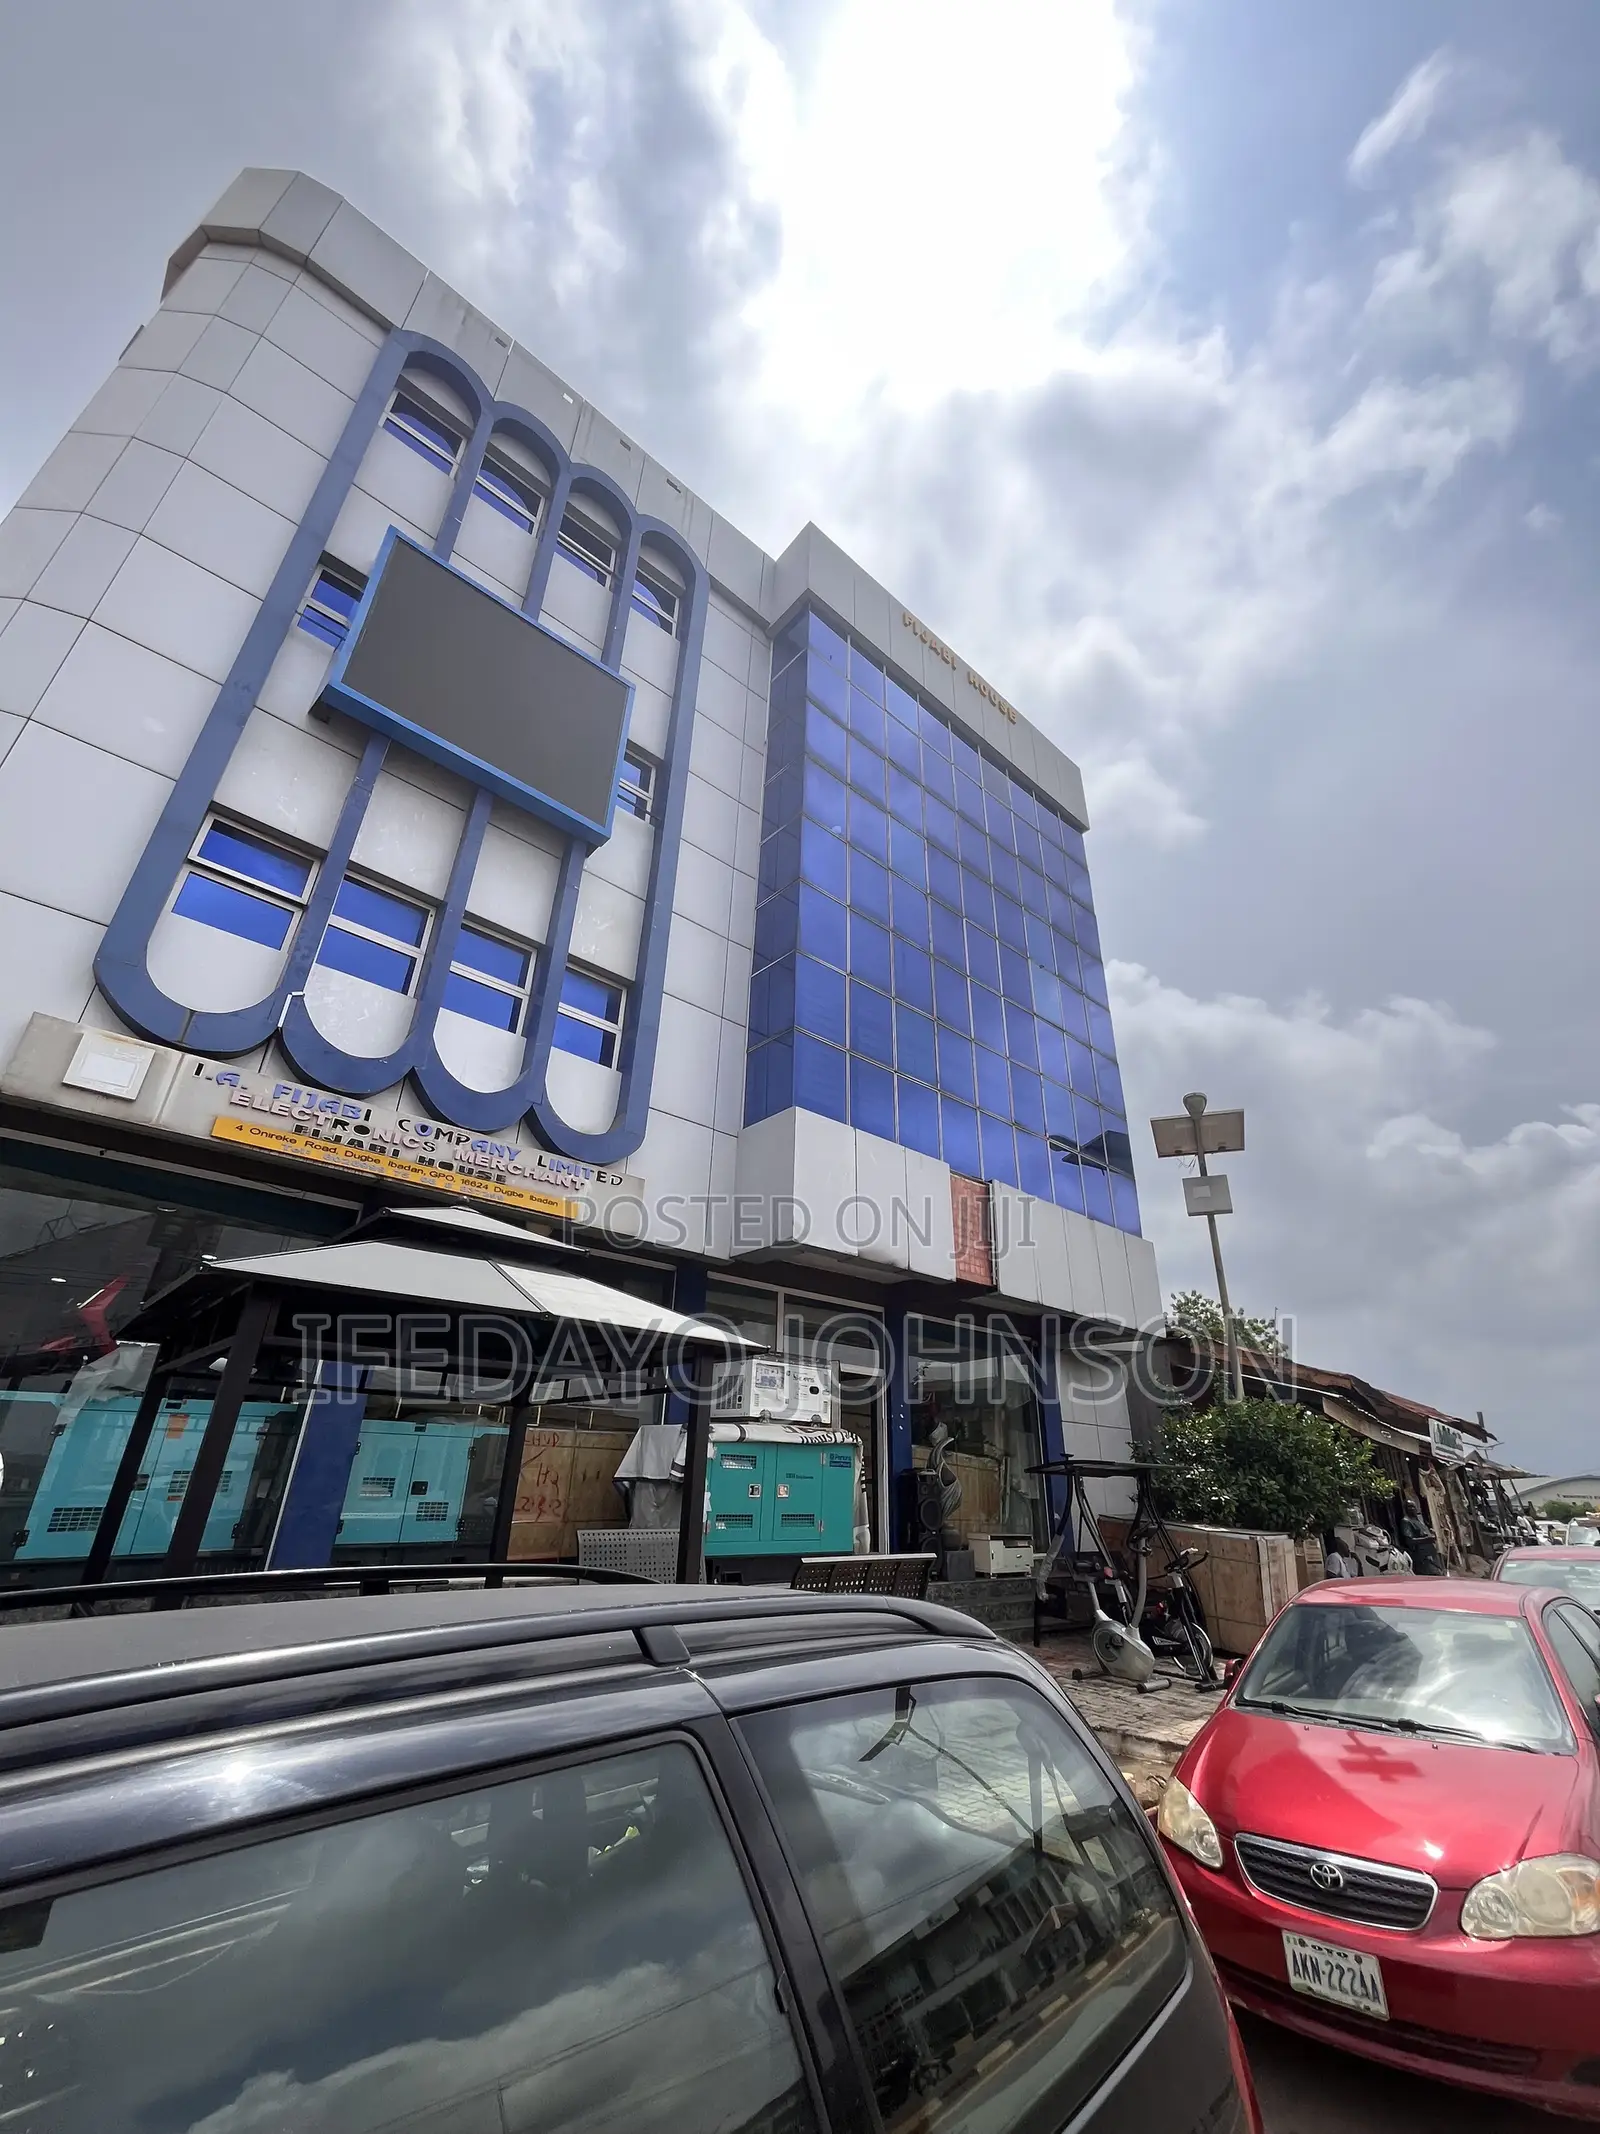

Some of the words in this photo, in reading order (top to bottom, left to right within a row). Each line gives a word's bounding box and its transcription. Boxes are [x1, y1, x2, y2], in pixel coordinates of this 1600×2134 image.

[904, 612, 957, 670] FIJABI
[968, 671, 1017, 725] HOUSE
[230, 1090, 436, 1153] ELECTRONICS
[454, 1148, 586, 1192] MERCHANT
[235, 1124, 244, 1132] 4
[249, 1126, 297, 1144] Onireke
[304, 1139, 339, 1155] Road,
[344, 1149, 381, 1166] Dugbe
[387, 1160, 427, 1176] Ibadan,
[429, 1170, 456, 1184] GPO,
[493, 1186, 524, 1200] Dugbe
[529, 1194, 559, 1207] Ibadan
[272, 1083, 373, 1122] FIJABI
[397, 1118, 522, 1161] COMPANY
[537, 1154, 624, 1187] LIMITED
[292, 1122, 401, 1160] FIJABI
[415, 1153, 508, 1185] HOUSE
[1292, 1949, 1381, 2005] AKN-222AA
